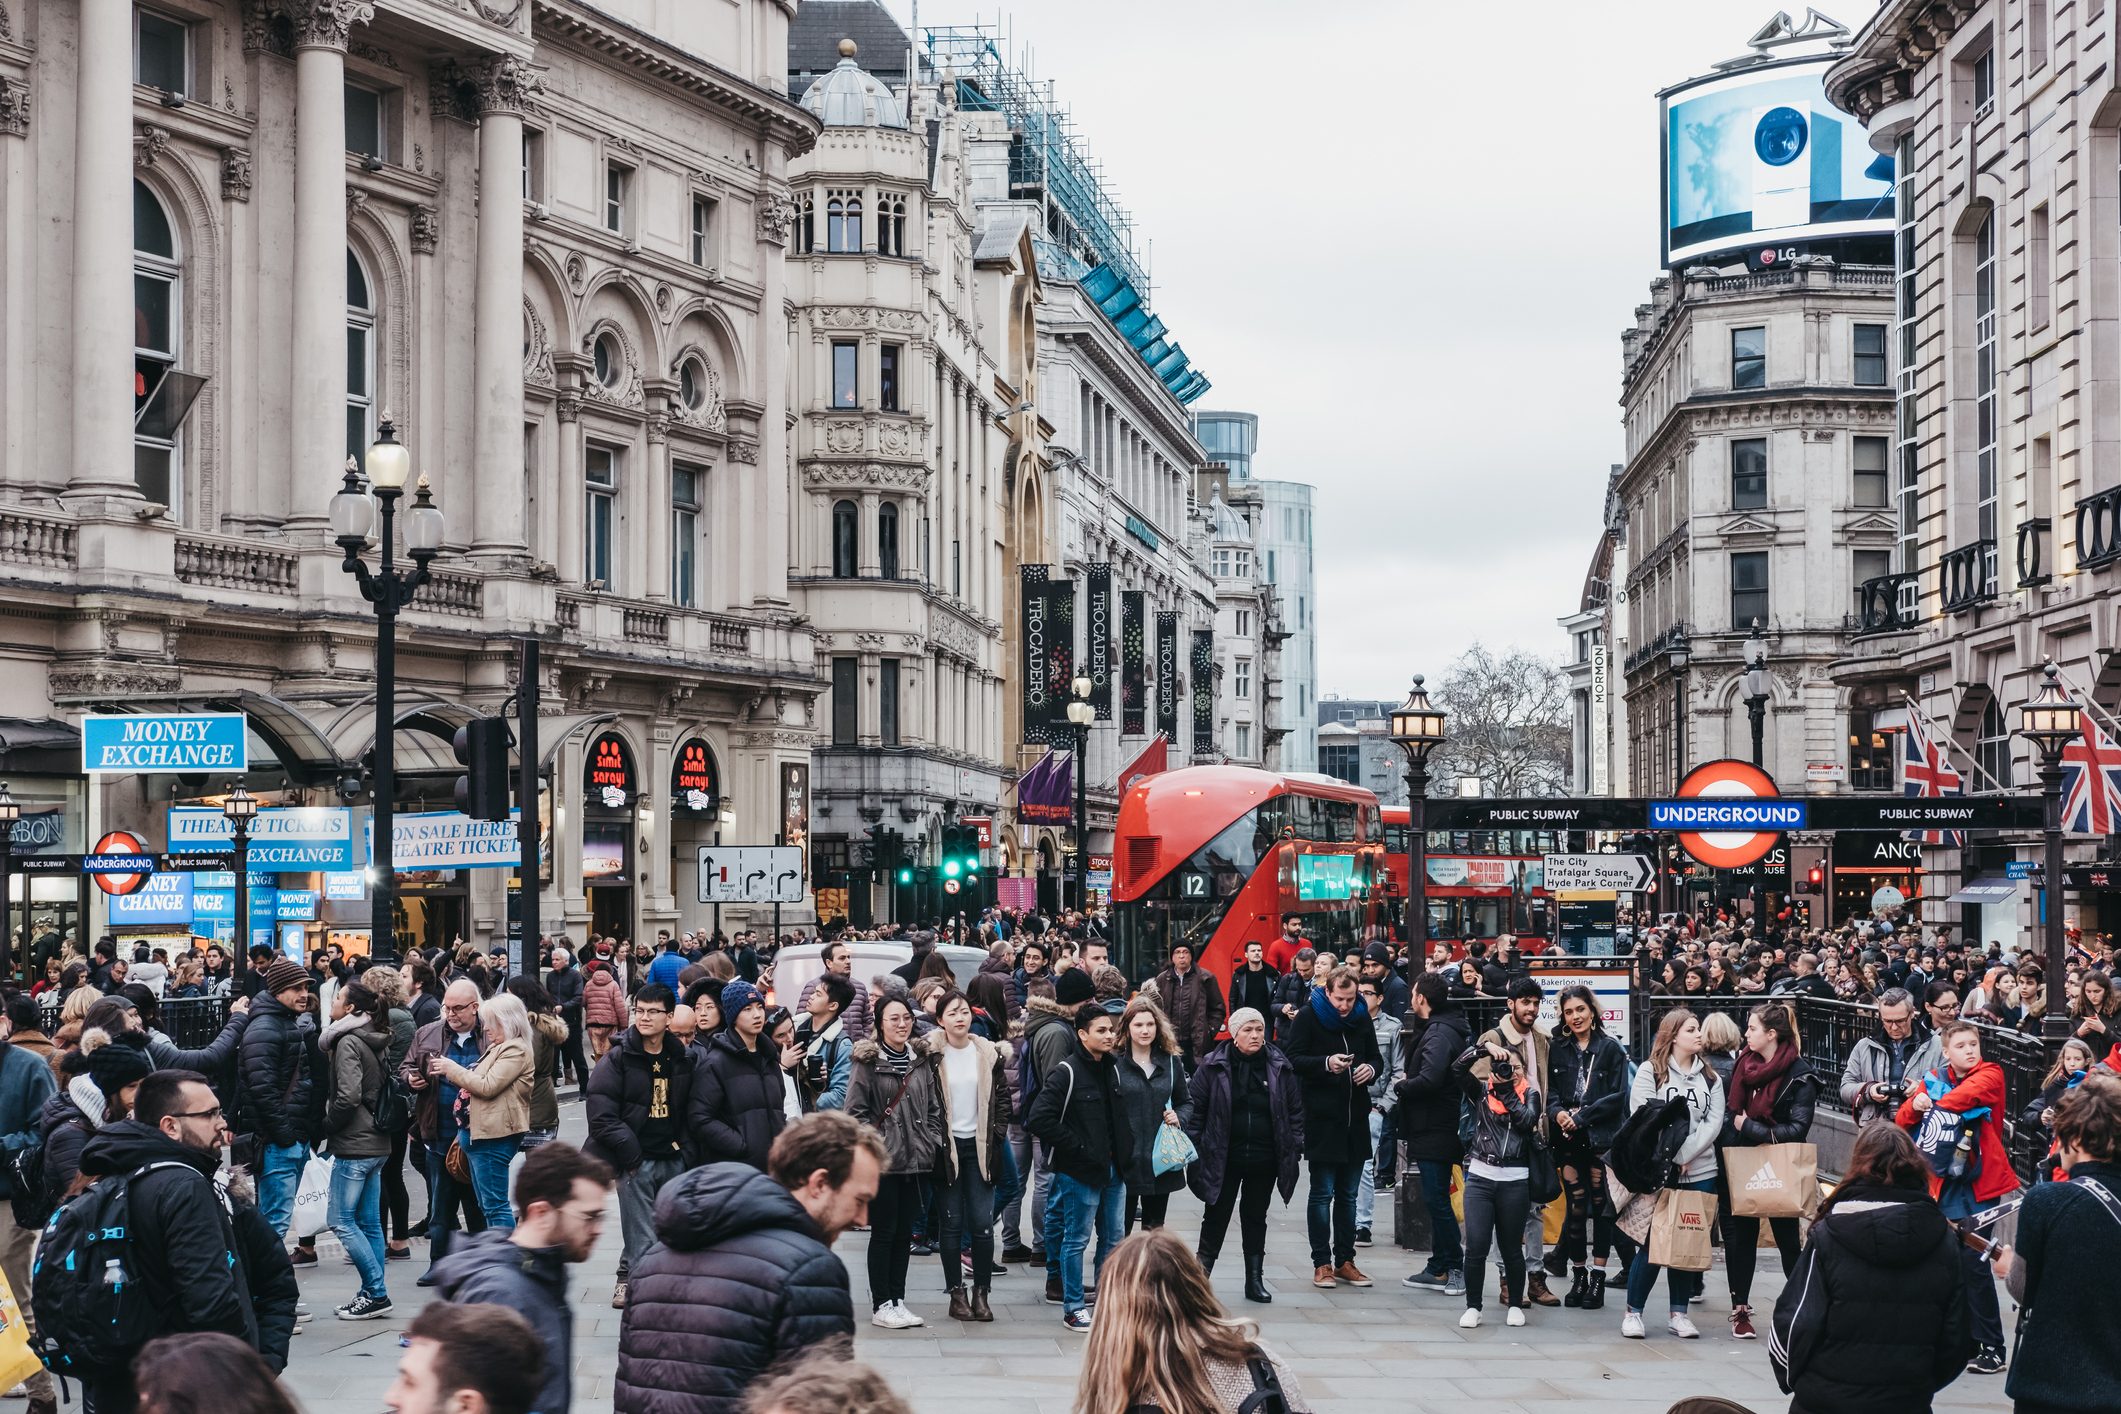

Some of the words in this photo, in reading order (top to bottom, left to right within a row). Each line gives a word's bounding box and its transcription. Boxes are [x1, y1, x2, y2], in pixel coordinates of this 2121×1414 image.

[1778, 247, 1796, 262] LG
[1093, 591, 1105, 686] TROCADERO
[1028, 597, 1044, 705] TROCADERO
[1161, 636, 1172, 715] TROCADERO
[1594, 647, 1605, 703] MORMON
[121, 720, 214, 742] MONEY
[1595, 728, 1606, 764] BOOK
[99, 744, 234, 766] EXCHANGE
[1490, 810, 1530, 820] PUBLIC
[1532, 809, 1580, 820] SUBWAY
[1654, 807, 1801, 822] UNDERGROUND
[1879, 809, 1922, 819] PUBLIC
[1924, 808, 1975, 819] SUBWAY
[180, 819, 263, 833] THEATE
[392, 826, 415, 841] ON
[418, 824, 461, 840] SALE
[464, 821, 512, 837] HERE
[393, 842, 455, 858] EATRE
[458, 838, 519, 855] TICKET
[1874, 842, 1922, 859] ANG
[246, 848, 344, 863] EXCHANGE
[1091, 858, 1110, 866] STOCK
[1548, 857, 1565, 866] The
[1568, 857, 1588, 867] City
[43, 860, 66, 868] SUBWAY
[84, 858, 152, 869] UNDERGROUND
[1732, 866, 1755, 875] EAK
[1764, 866, 1785, 875] USE
[218, 875, 275, 885] EXANGE
[330, 875, 360, 885] MONEY
[1547, 868, 1591, 880] Trafalgar
[1595, 868, 1629, 880] Square
[141, 875, 182, 892] NEY
[328, 885, 361, 895] CHANGE
[1186, 875, 1204, 895] 12
[1547, 879, 1571, 888] Hyde
[1575, 879, 1597, 887] Park
[1600, 879, 1633, 887] Corner
[119, 894, 184, 911] CHANGE
[193, 895, 224, 911] NGE
[280, 894, 311, 904] MONEY
[277, 907, 313, 917] CHANGE
[1541, 978, 1576, 986] Bakerloo
[1579, 978, 1594, 986] line
[1745, 1178, 1783, 1191] adidas
[296, 1188, 330, 1206] OPSH
[1679, 1212, 1701, 1225] VANS
